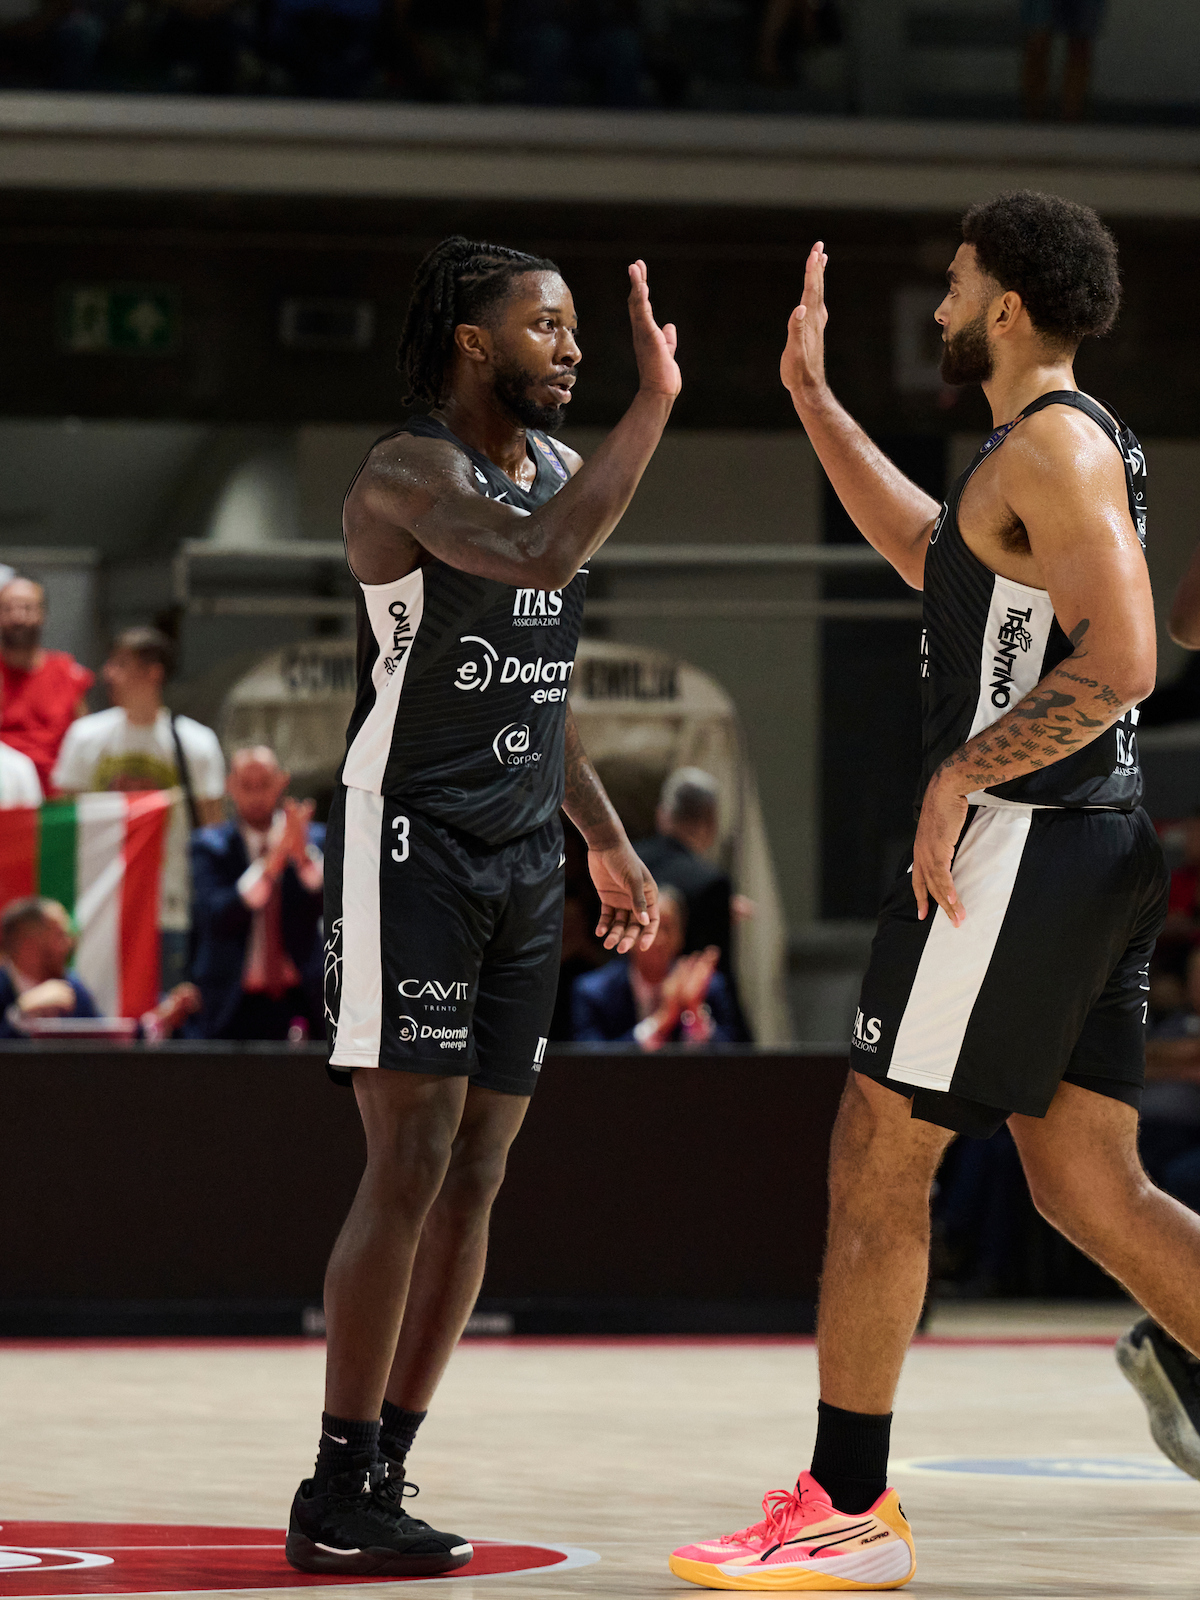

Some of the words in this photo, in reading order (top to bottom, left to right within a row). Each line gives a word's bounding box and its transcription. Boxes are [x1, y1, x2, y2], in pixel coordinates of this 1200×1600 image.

[512, 588, 563, 616] ITAS
[500, 657, 574, 684] Dolom
[989, 607, 1032, 708] TRENTINO
[392, 816, 410, 862] 3
[398, 979, 469, 1001] CAVIT
